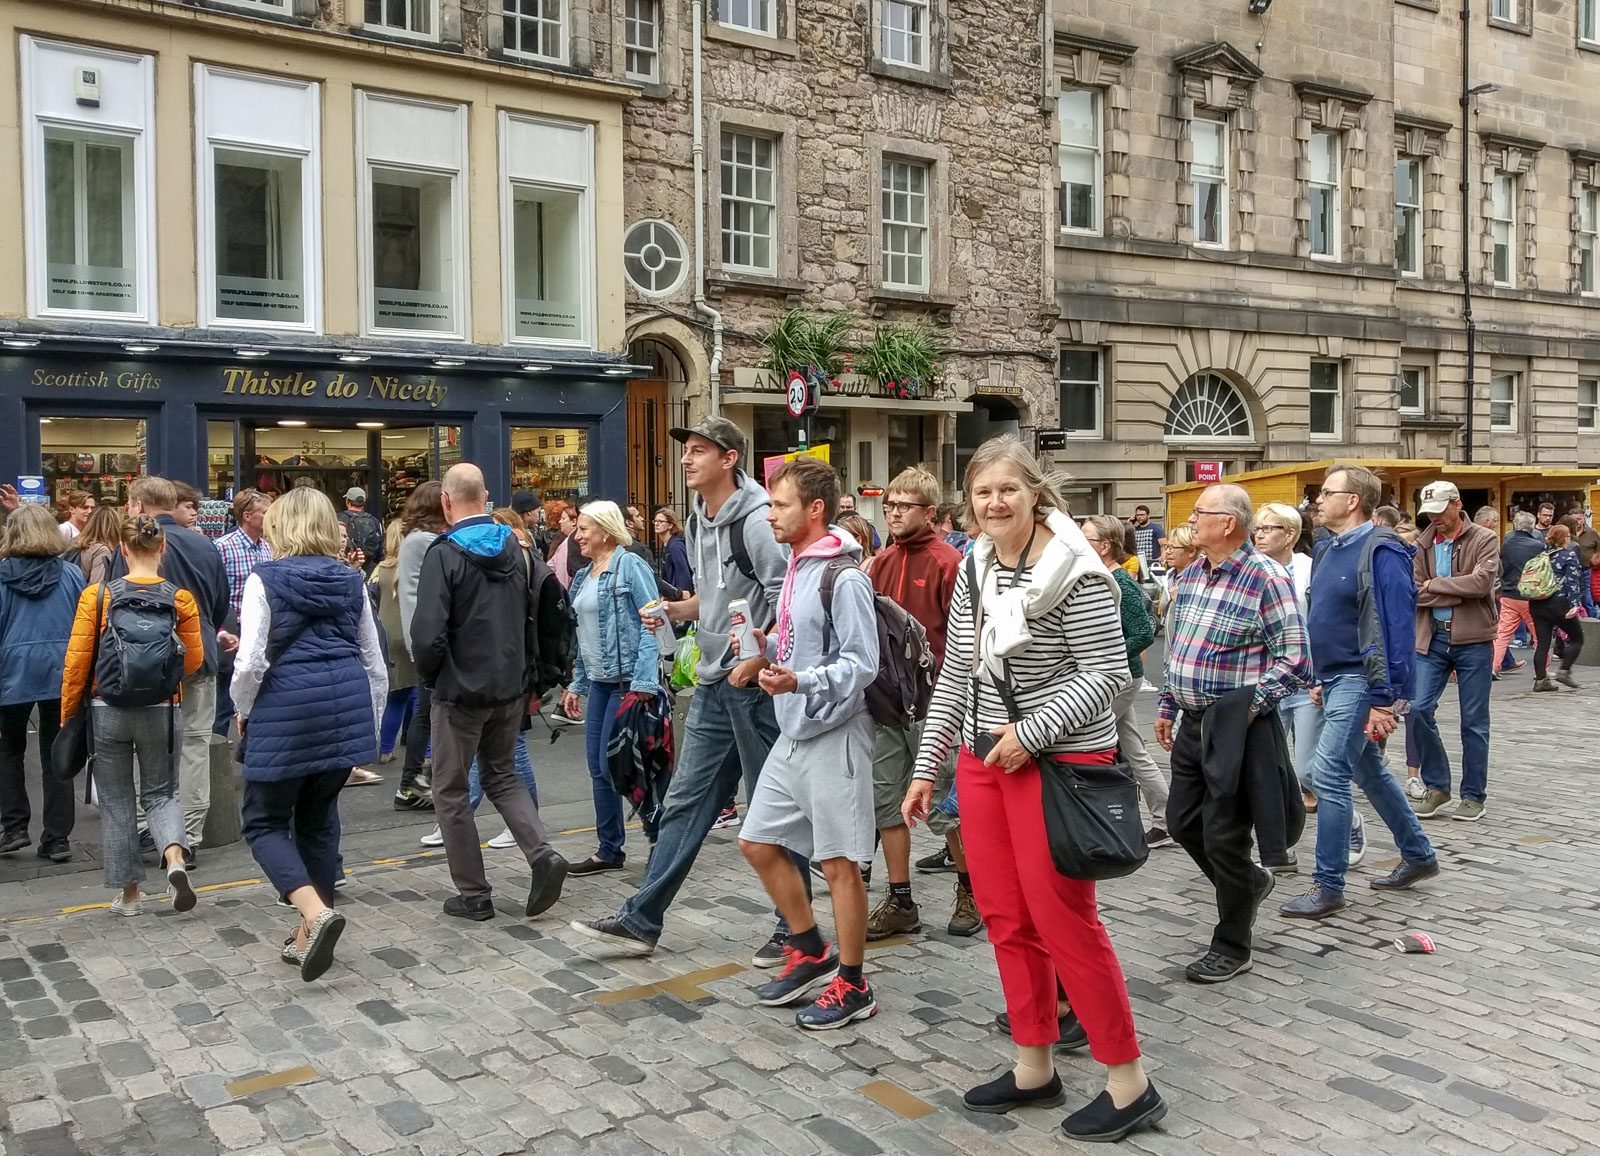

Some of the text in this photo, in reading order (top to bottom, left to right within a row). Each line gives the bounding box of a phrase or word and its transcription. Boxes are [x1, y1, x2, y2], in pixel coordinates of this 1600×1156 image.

[31, 369, 161, 393] Scottish Gifts
[223, 368, 448, 408] Thistle do Nicely
[790, 387, 804, 404] 20
[302, 441, 326, 455] 351
[1424, 489, 1434, 500] H
